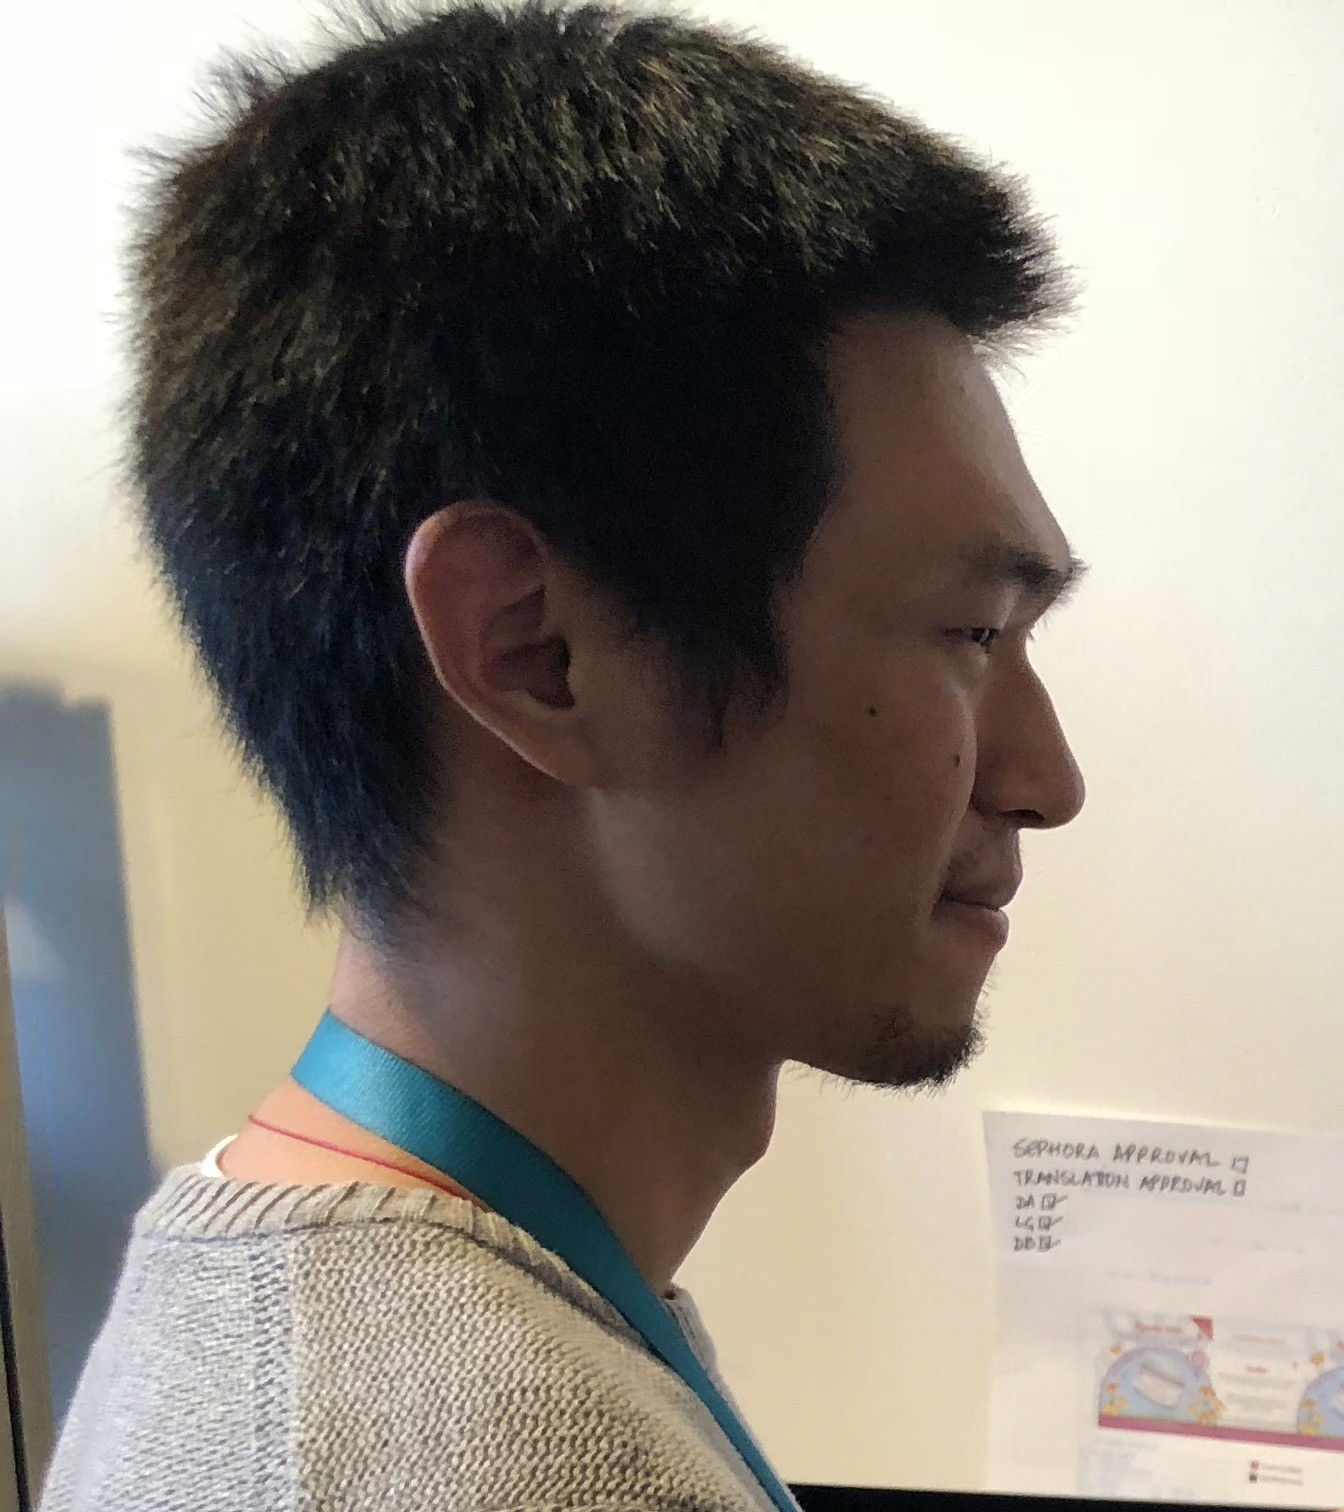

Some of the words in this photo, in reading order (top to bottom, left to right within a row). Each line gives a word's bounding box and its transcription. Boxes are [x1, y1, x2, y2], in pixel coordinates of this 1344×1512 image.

[1013, 1139, 1100, 1161] SEPHORA
[1112, 1143, 1220, 1167] APPROVAL
[1013, 1169, 1130, 1188] TRANSLATION
[1139, 1173, 1227, 1197] APPROVAL
